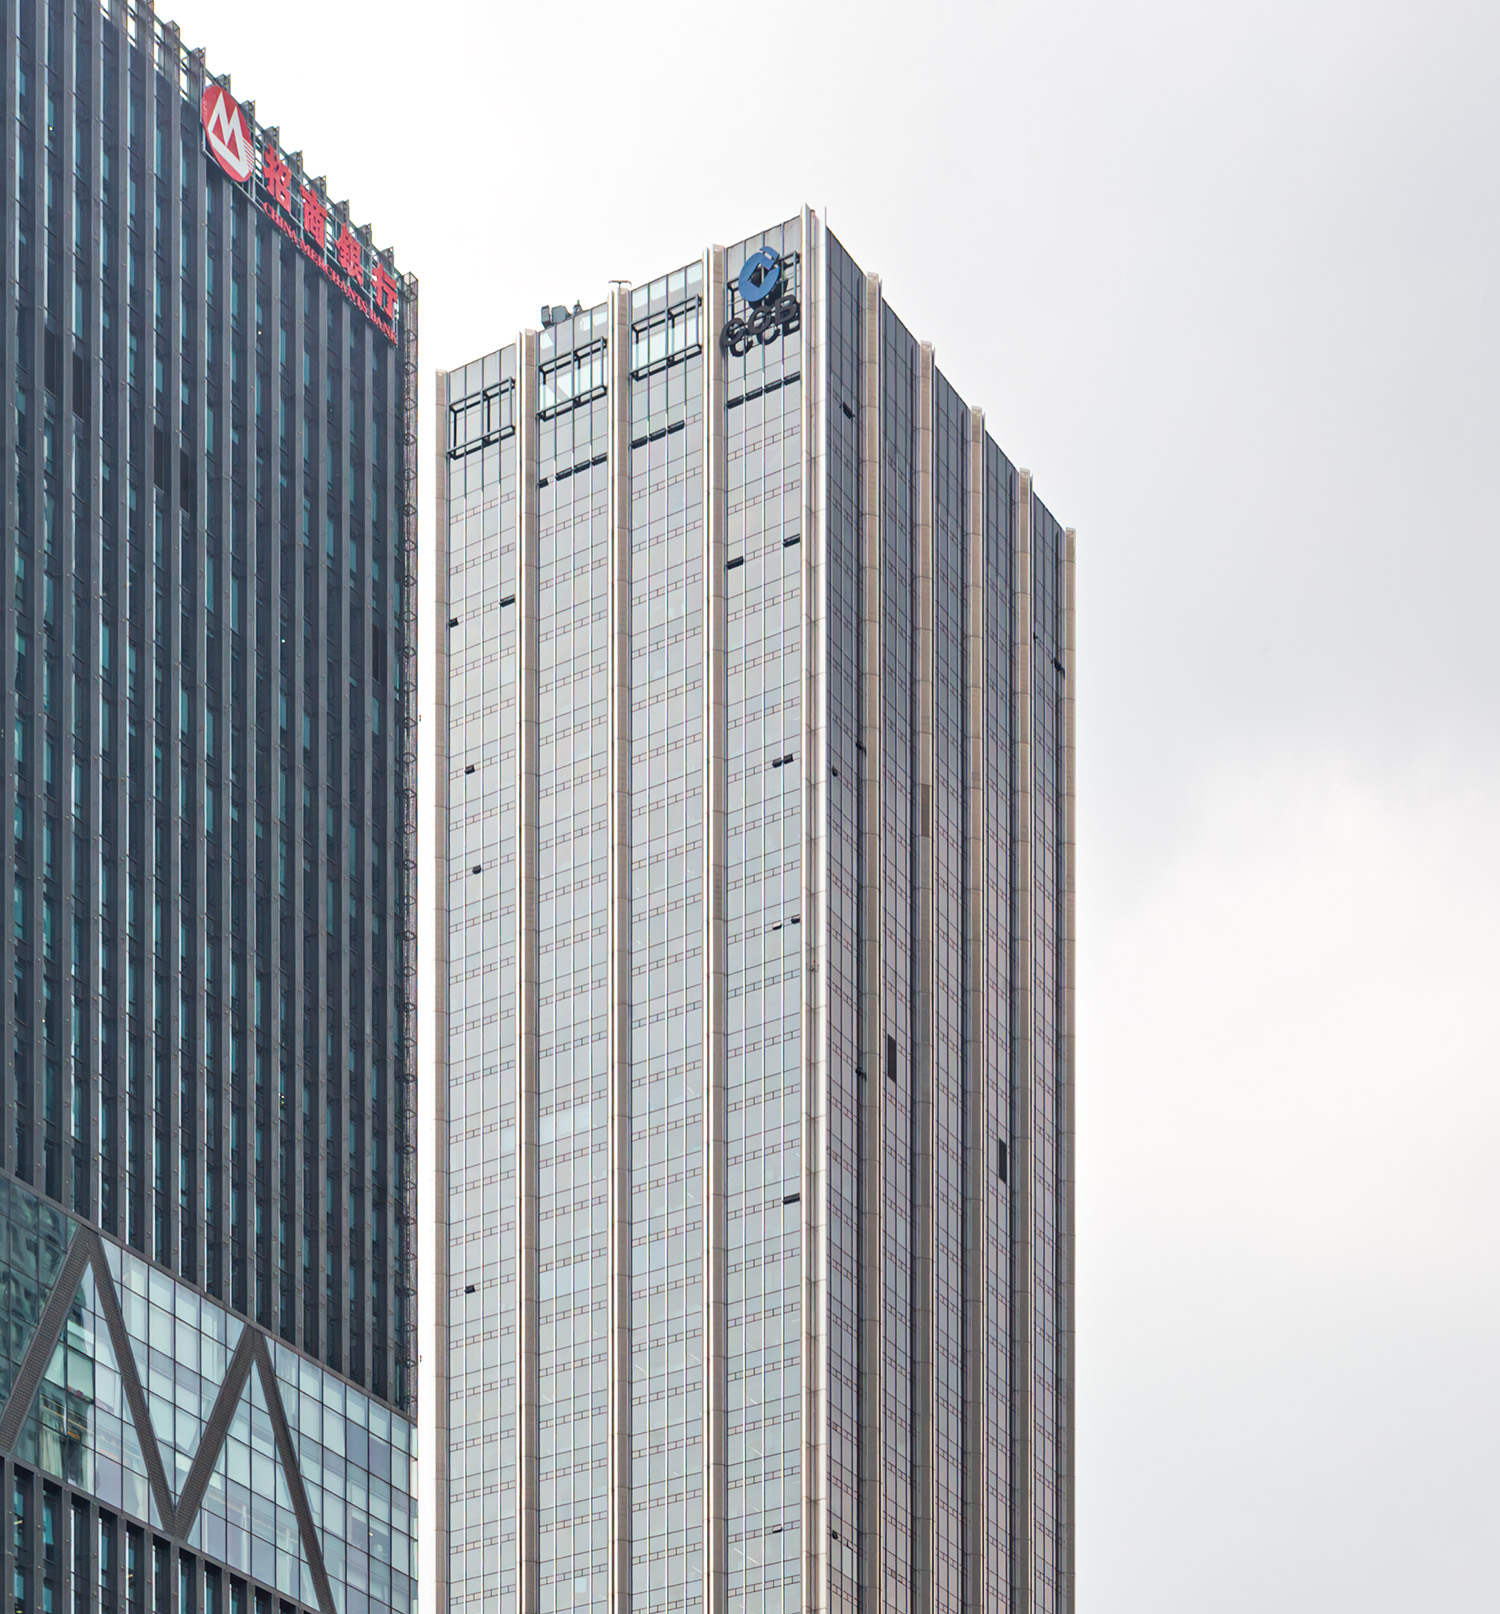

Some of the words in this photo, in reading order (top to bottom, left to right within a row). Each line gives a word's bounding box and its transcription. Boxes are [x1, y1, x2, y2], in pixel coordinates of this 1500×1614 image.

[263, 202, 298, 246] CHINA
[300, 239, 368, 315] MERCHANTS
[369, 308, 397, 346] BANK
[719, 294, 799, 347] CCB
